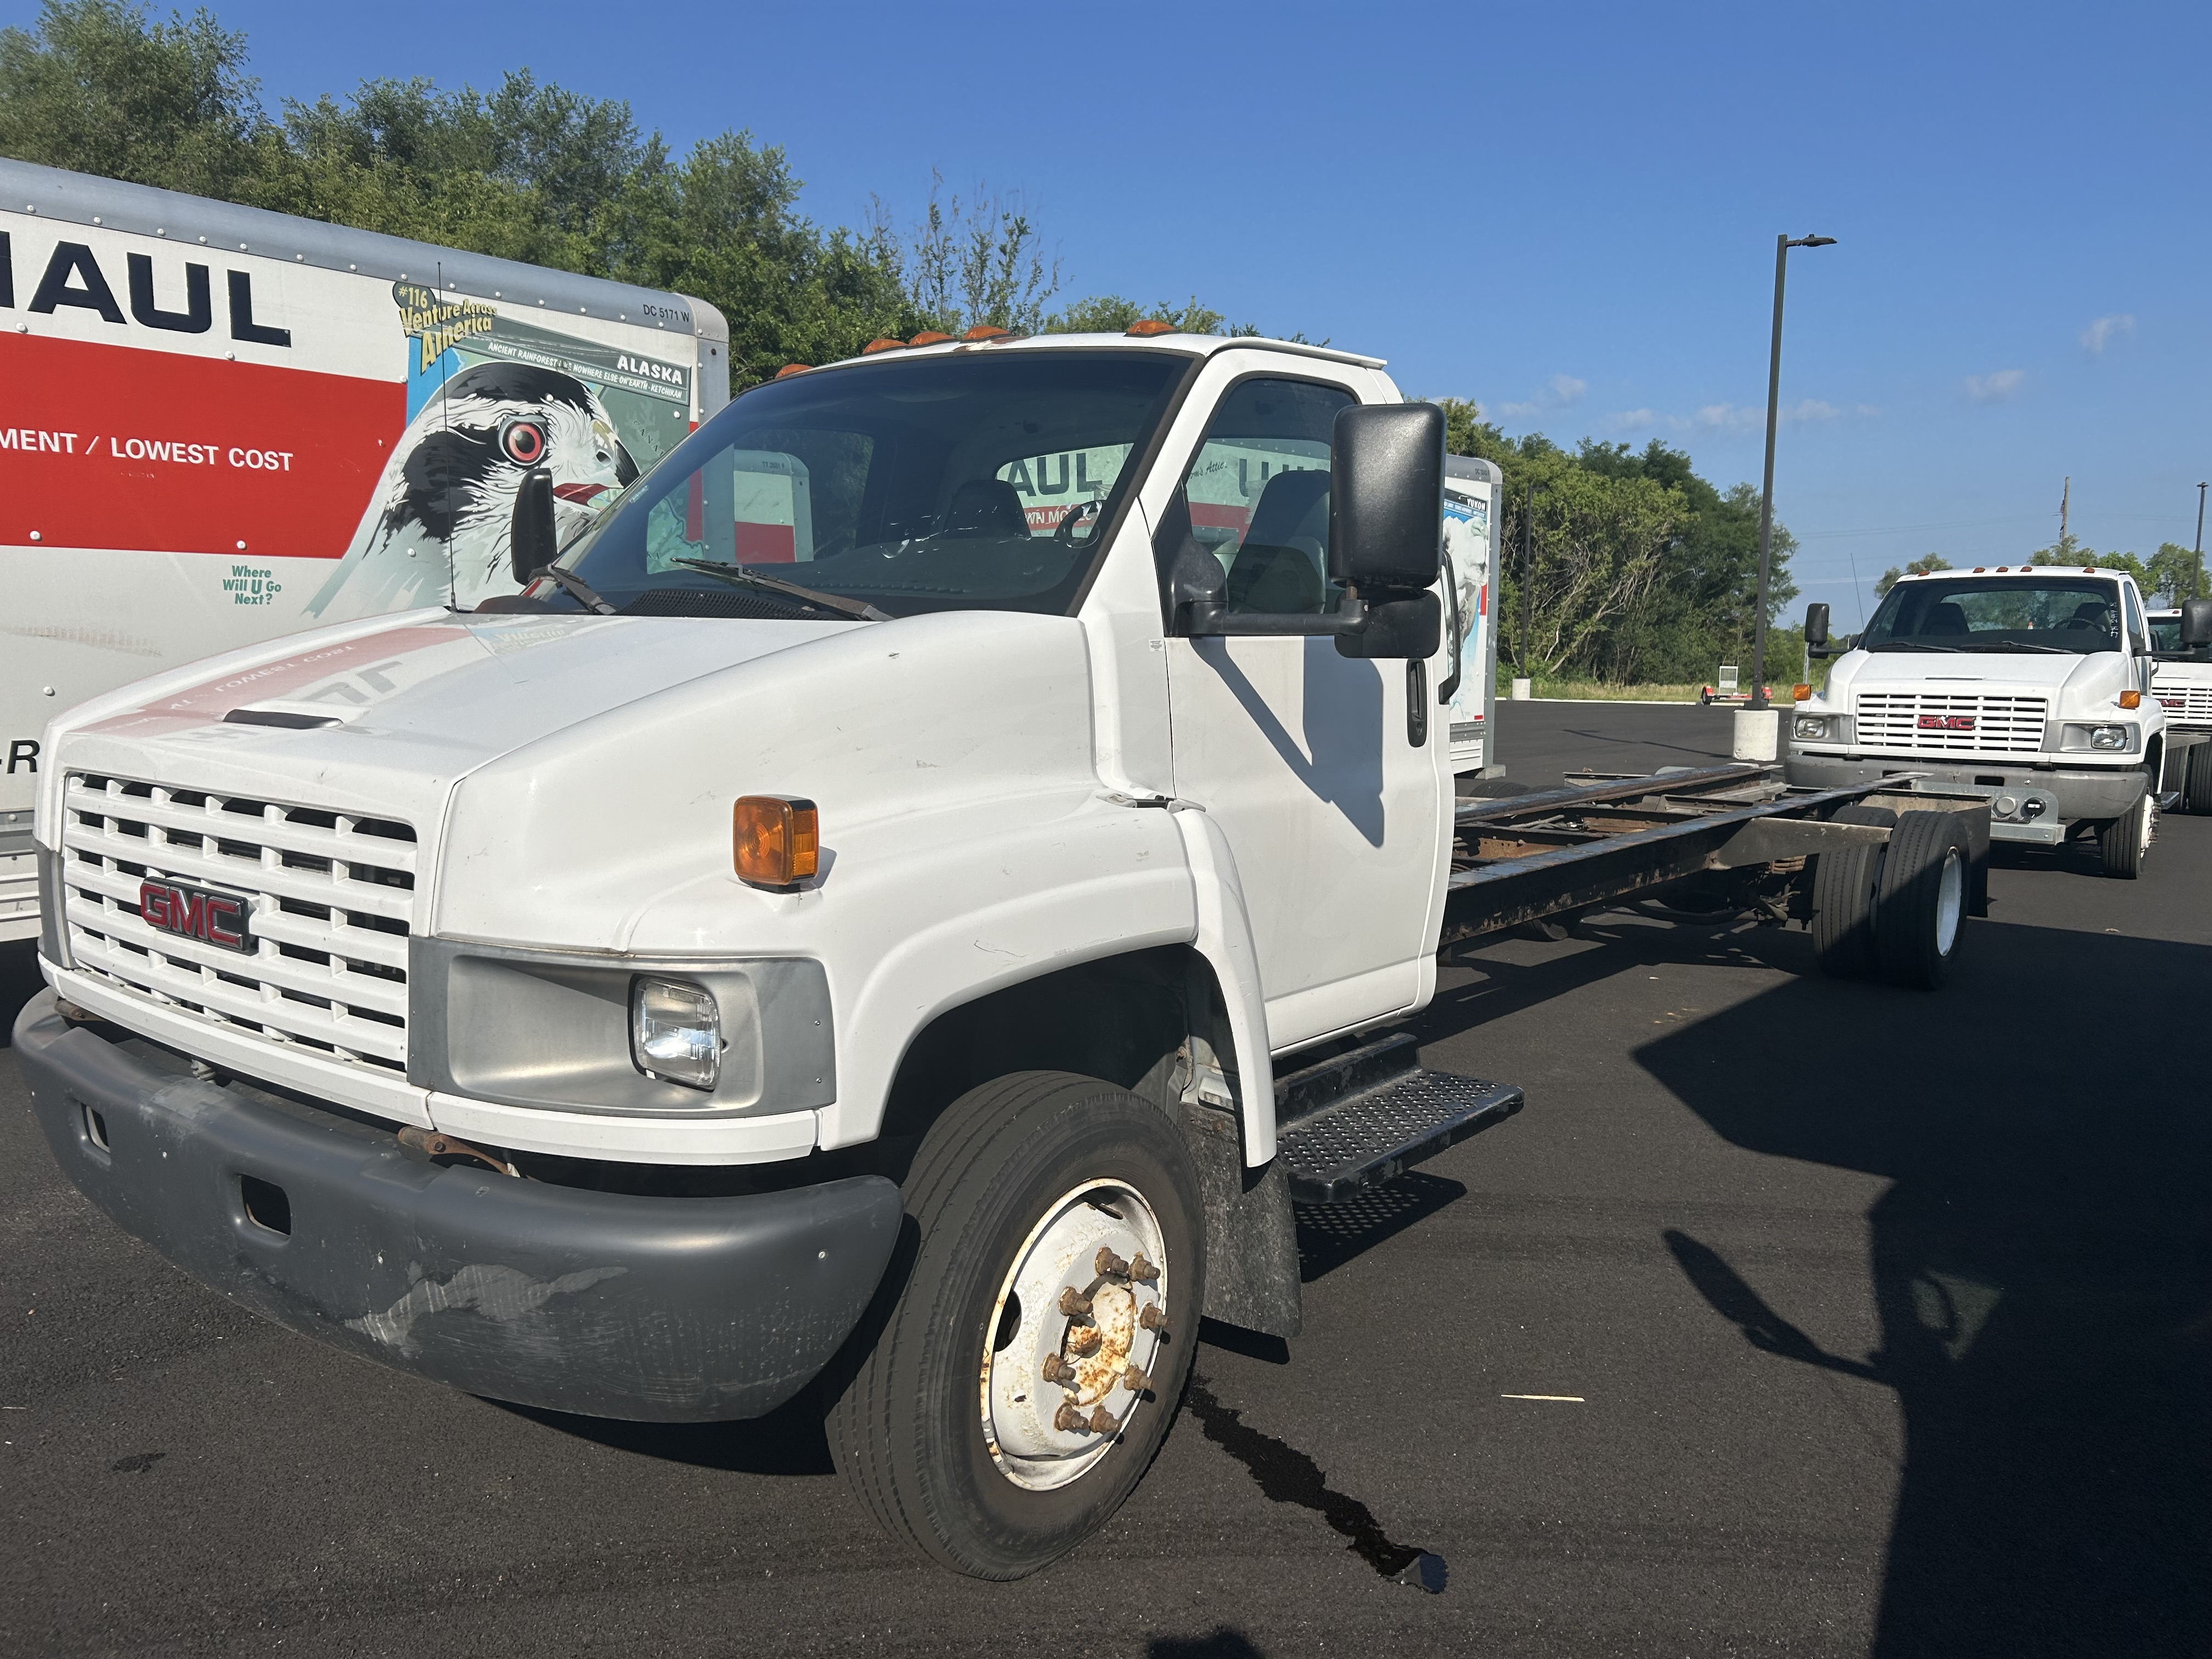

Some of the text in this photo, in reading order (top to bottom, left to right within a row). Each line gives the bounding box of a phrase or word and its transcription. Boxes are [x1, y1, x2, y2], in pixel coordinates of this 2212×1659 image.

[398, 286, 428, 309] #116
[399, 298, 498, 338] Venture Across
[643, 304, 690, 322] DC 5171 W
[421, 314, 492, 376] America
[488, 342, 517, 357] ANCIENT
[517, 349, 558, 368] RAINFOREST
[573, 364, 603, 379] NOWHERE
[603, 371, 618, 383] ELSE
[629, 379, 648, 390] EARTH
[651, 383, 682, 399] KETCHIKAN
[617, 355, 682, 385] ALASKA
[111, 437, 219, 465] LOWEST
[228, 448, 294, 471] COST
[1006, 453, 1103, 497] AUL
[1466, 498, 1486, 511] YUKON
[232, 565, 272, 578] Where
[223, 579, 281, 594] Will U Go
[2160, 699, 2186, 707] MC
[1918, 715, 1975, 730] GMC
[140, 879, 244, 950] GMC
